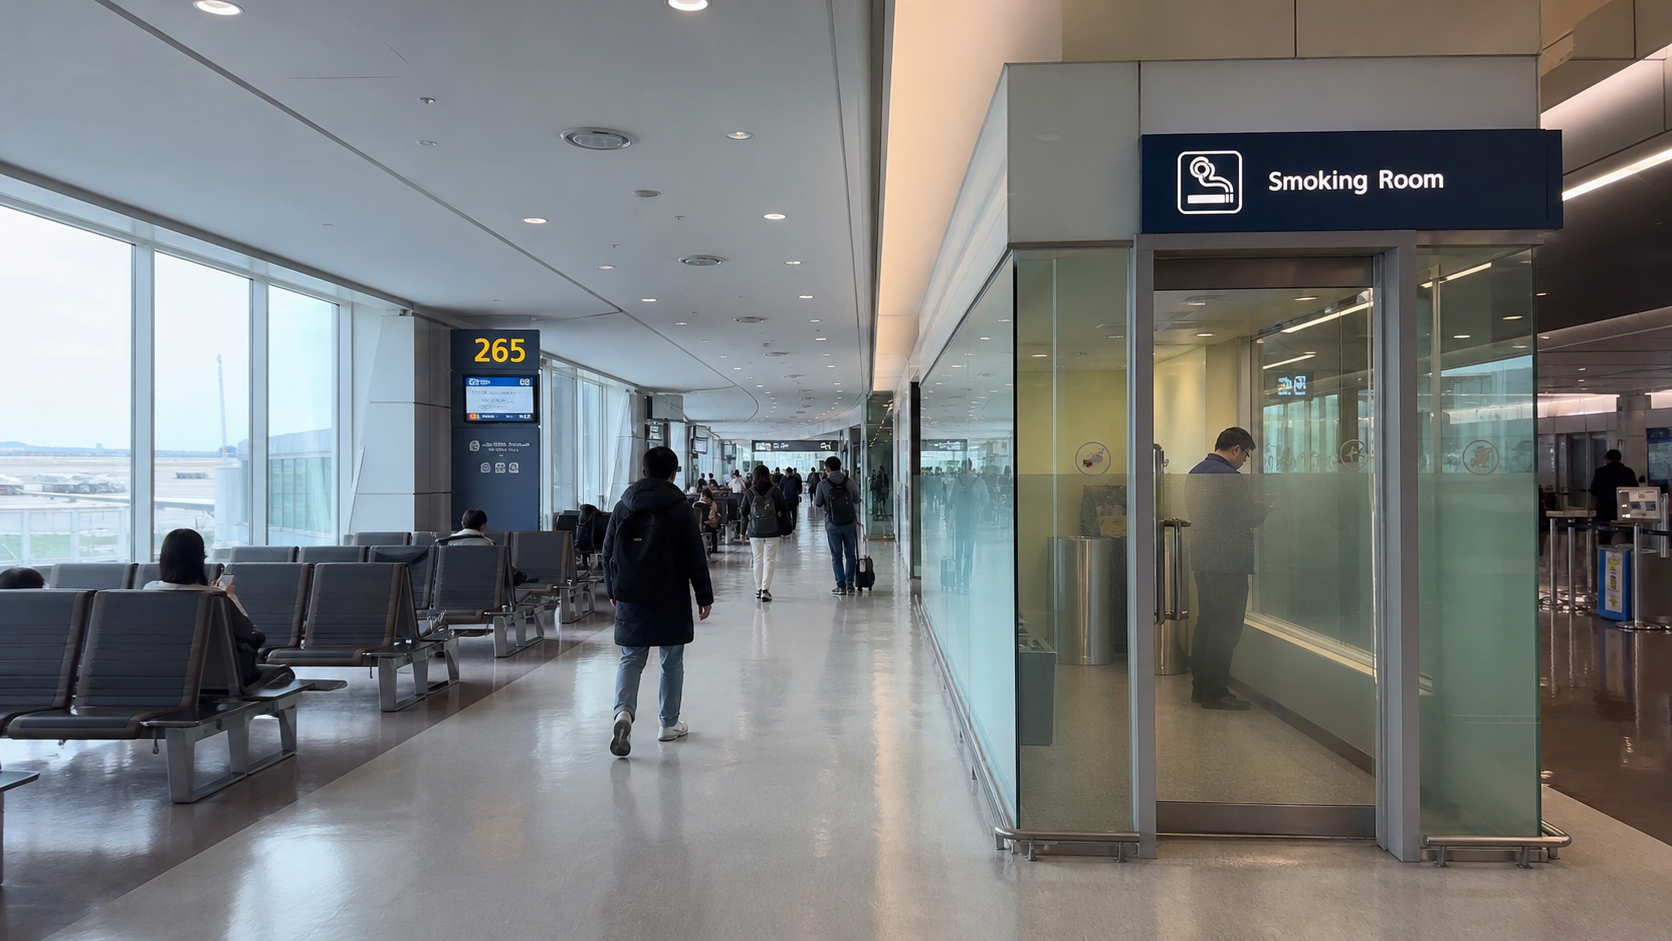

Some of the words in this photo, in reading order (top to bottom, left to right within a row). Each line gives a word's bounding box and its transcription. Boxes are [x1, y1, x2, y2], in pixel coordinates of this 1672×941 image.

[1268, 169, 1368, 195] Smoking
[1379, 169, 1444, 190] Room
[474, 337, 526, 363] 265
